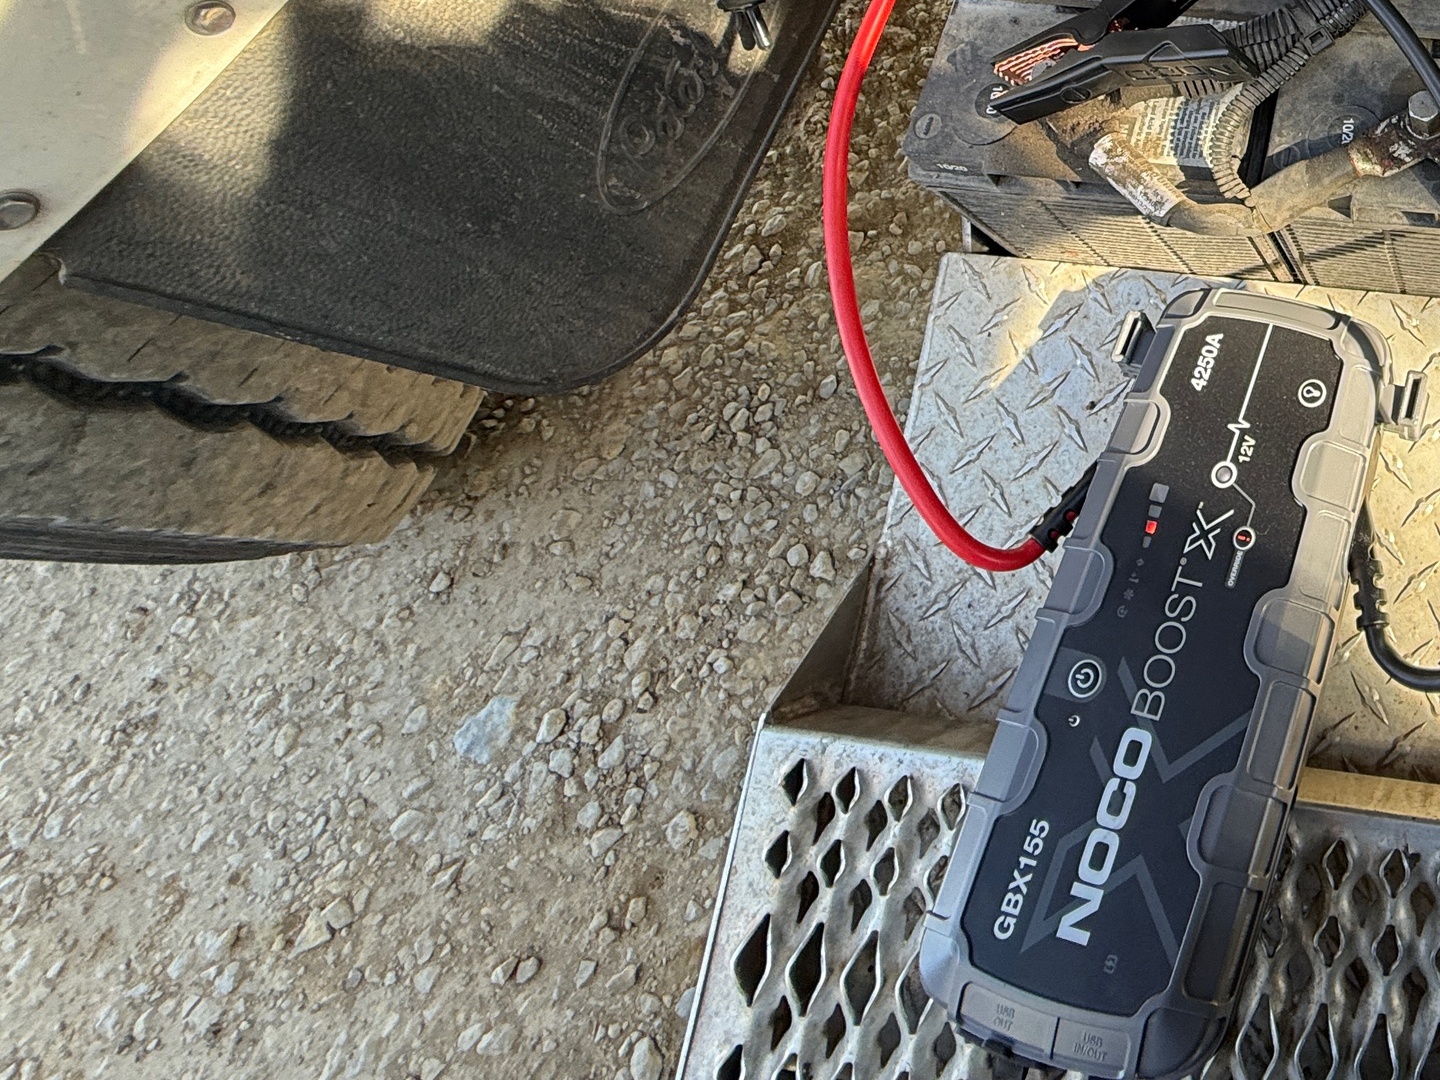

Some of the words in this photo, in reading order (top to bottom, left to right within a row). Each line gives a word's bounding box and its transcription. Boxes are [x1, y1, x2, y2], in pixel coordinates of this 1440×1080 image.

[1339, 118, 1356, 144] 10/2
[1190, 333, 1223, 392] 4250A
[1238, 436, 1256, 463] 12V
[1227, 551, 1244, 586] OVERRIDE
[1056, 727, 1152, 946] NOCO
[993, 819, 1050, 940] GBX155
[1072, 1042, 1108, 1062] IN/OUT
[1082, 1032, 1103, 1048] USB
